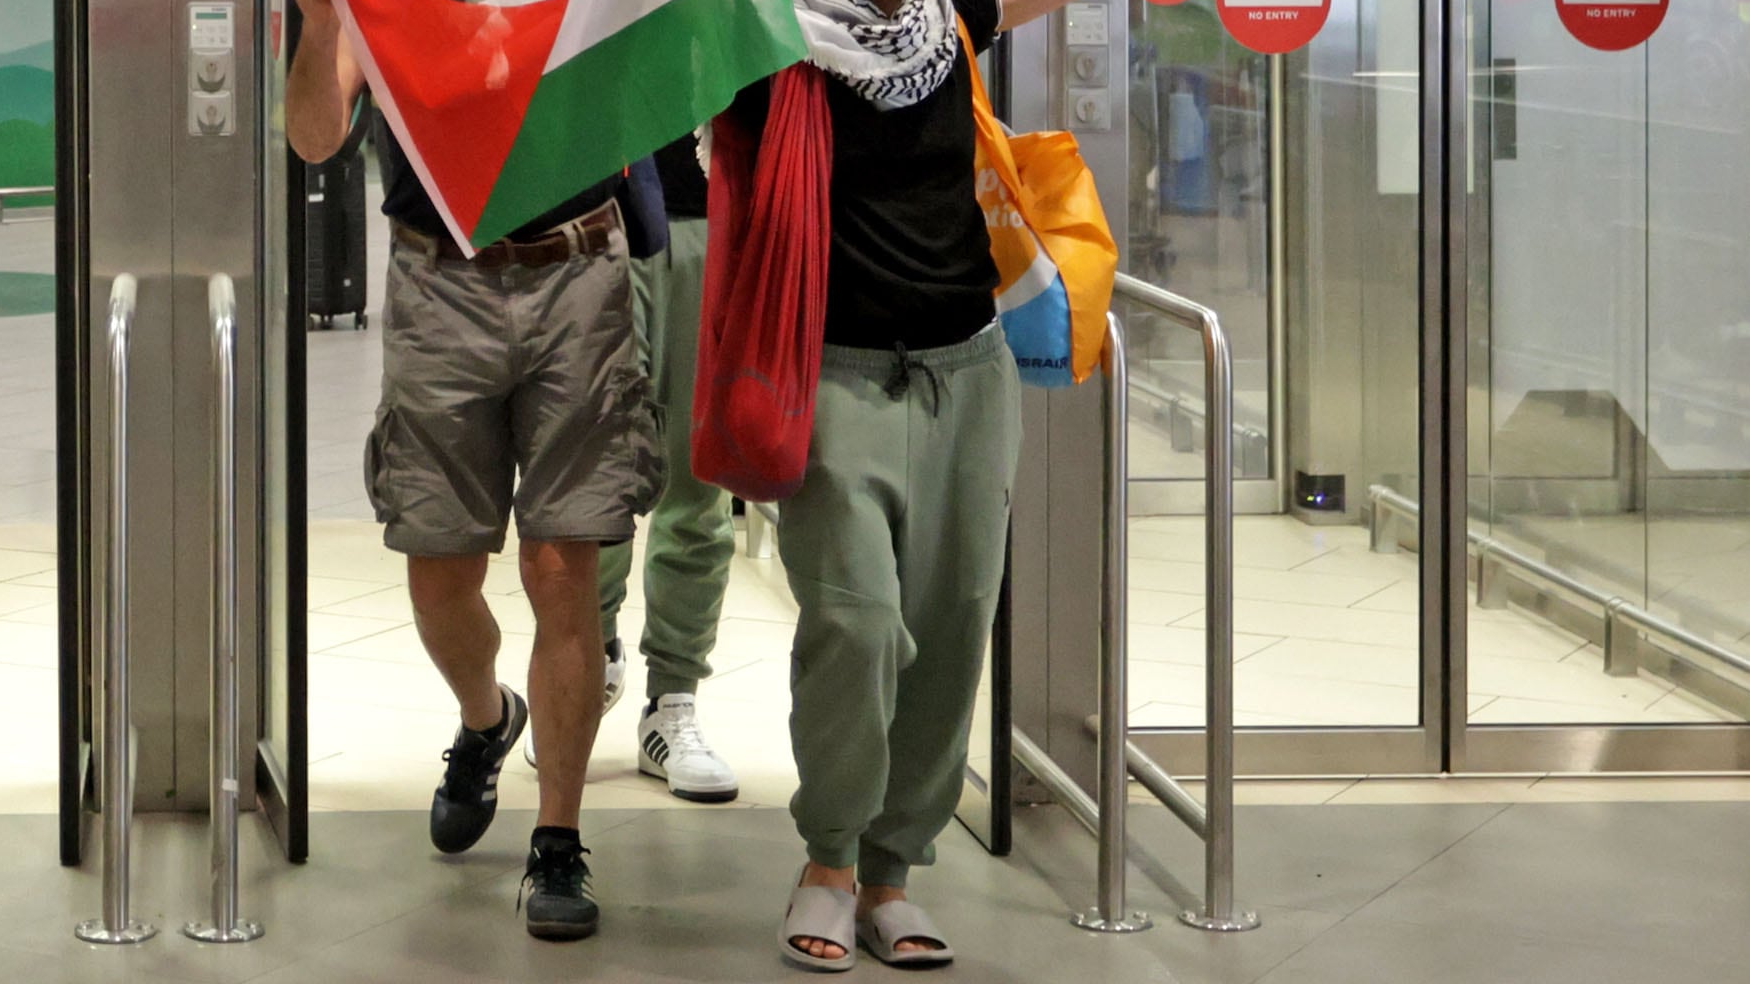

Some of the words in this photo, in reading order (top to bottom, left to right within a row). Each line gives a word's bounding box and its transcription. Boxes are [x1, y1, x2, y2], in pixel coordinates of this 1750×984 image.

[1248, 11, 1263, 20] NO
[1266, 11, 1299, 20] ENTRY
[1586, 9, 1600, 18] NO
[1603, 9, 1636, 18] ENTRY
